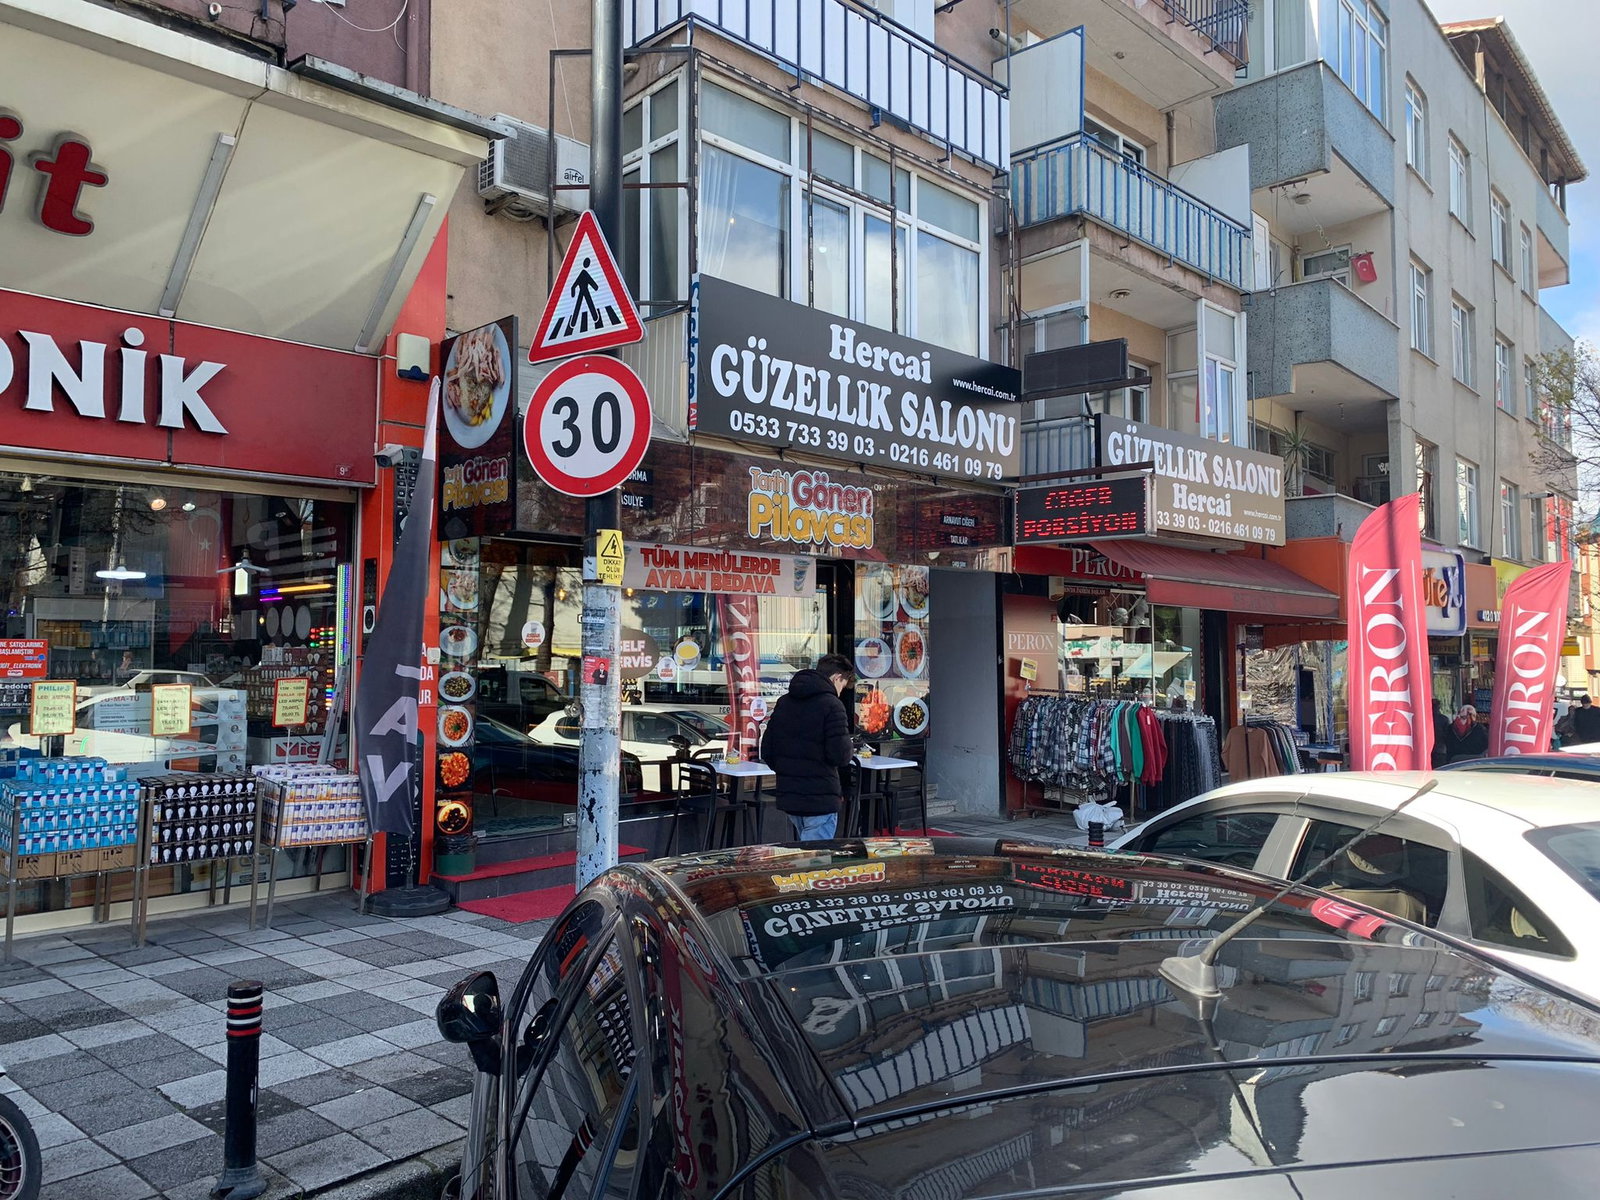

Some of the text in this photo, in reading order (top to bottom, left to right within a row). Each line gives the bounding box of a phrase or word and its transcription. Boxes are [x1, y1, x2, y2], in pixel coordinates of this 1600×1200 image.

[564, 170, 585, 184] airfel
[829, 324, 932, 384] Hercai
[0, 327, 229, 434] NİK
[710, 335, 1016, 457] GÜZELLİK SALONU
[953, 378, 1017, 401] www.hercai.com.tr
[551, 391, 622, 458] 30
[730, 410, 780, 438] 0533
[786, 422, 821, 446] 733
[827, 430, 848, 451] 39
[854, 435, 874, 456] 03
[890, 442, 929, 466] 0216
[933, 452, 959, 472] 461
[965, 458, 982, 476] 09
[986, 462, 1003, 480] 79
[464, 456, 508, 483] Gönen
[1212, 454, 1281, 498] SALONU
[792, 471, 873, 515] Gönen
[1172, 483, 1232, 517] Hercai
[1173, 514, 1185, 528] 39
[1188, 516, 1200, 530] 03
[1208, 519, 1231, 534] 0216
[1234, 523, 1250, 538] 461
[1253, 526, 1263, 540] 09
[1265, 528, 1276, 541] 79
[640, 545, 780, 575] TÜM MENÜLERDE
[645, 569, 776, 594] AYRAN BEDAVA
[1008, 634, 1054, 650] PERON
[618, 652, 653, 668] ERVİS
